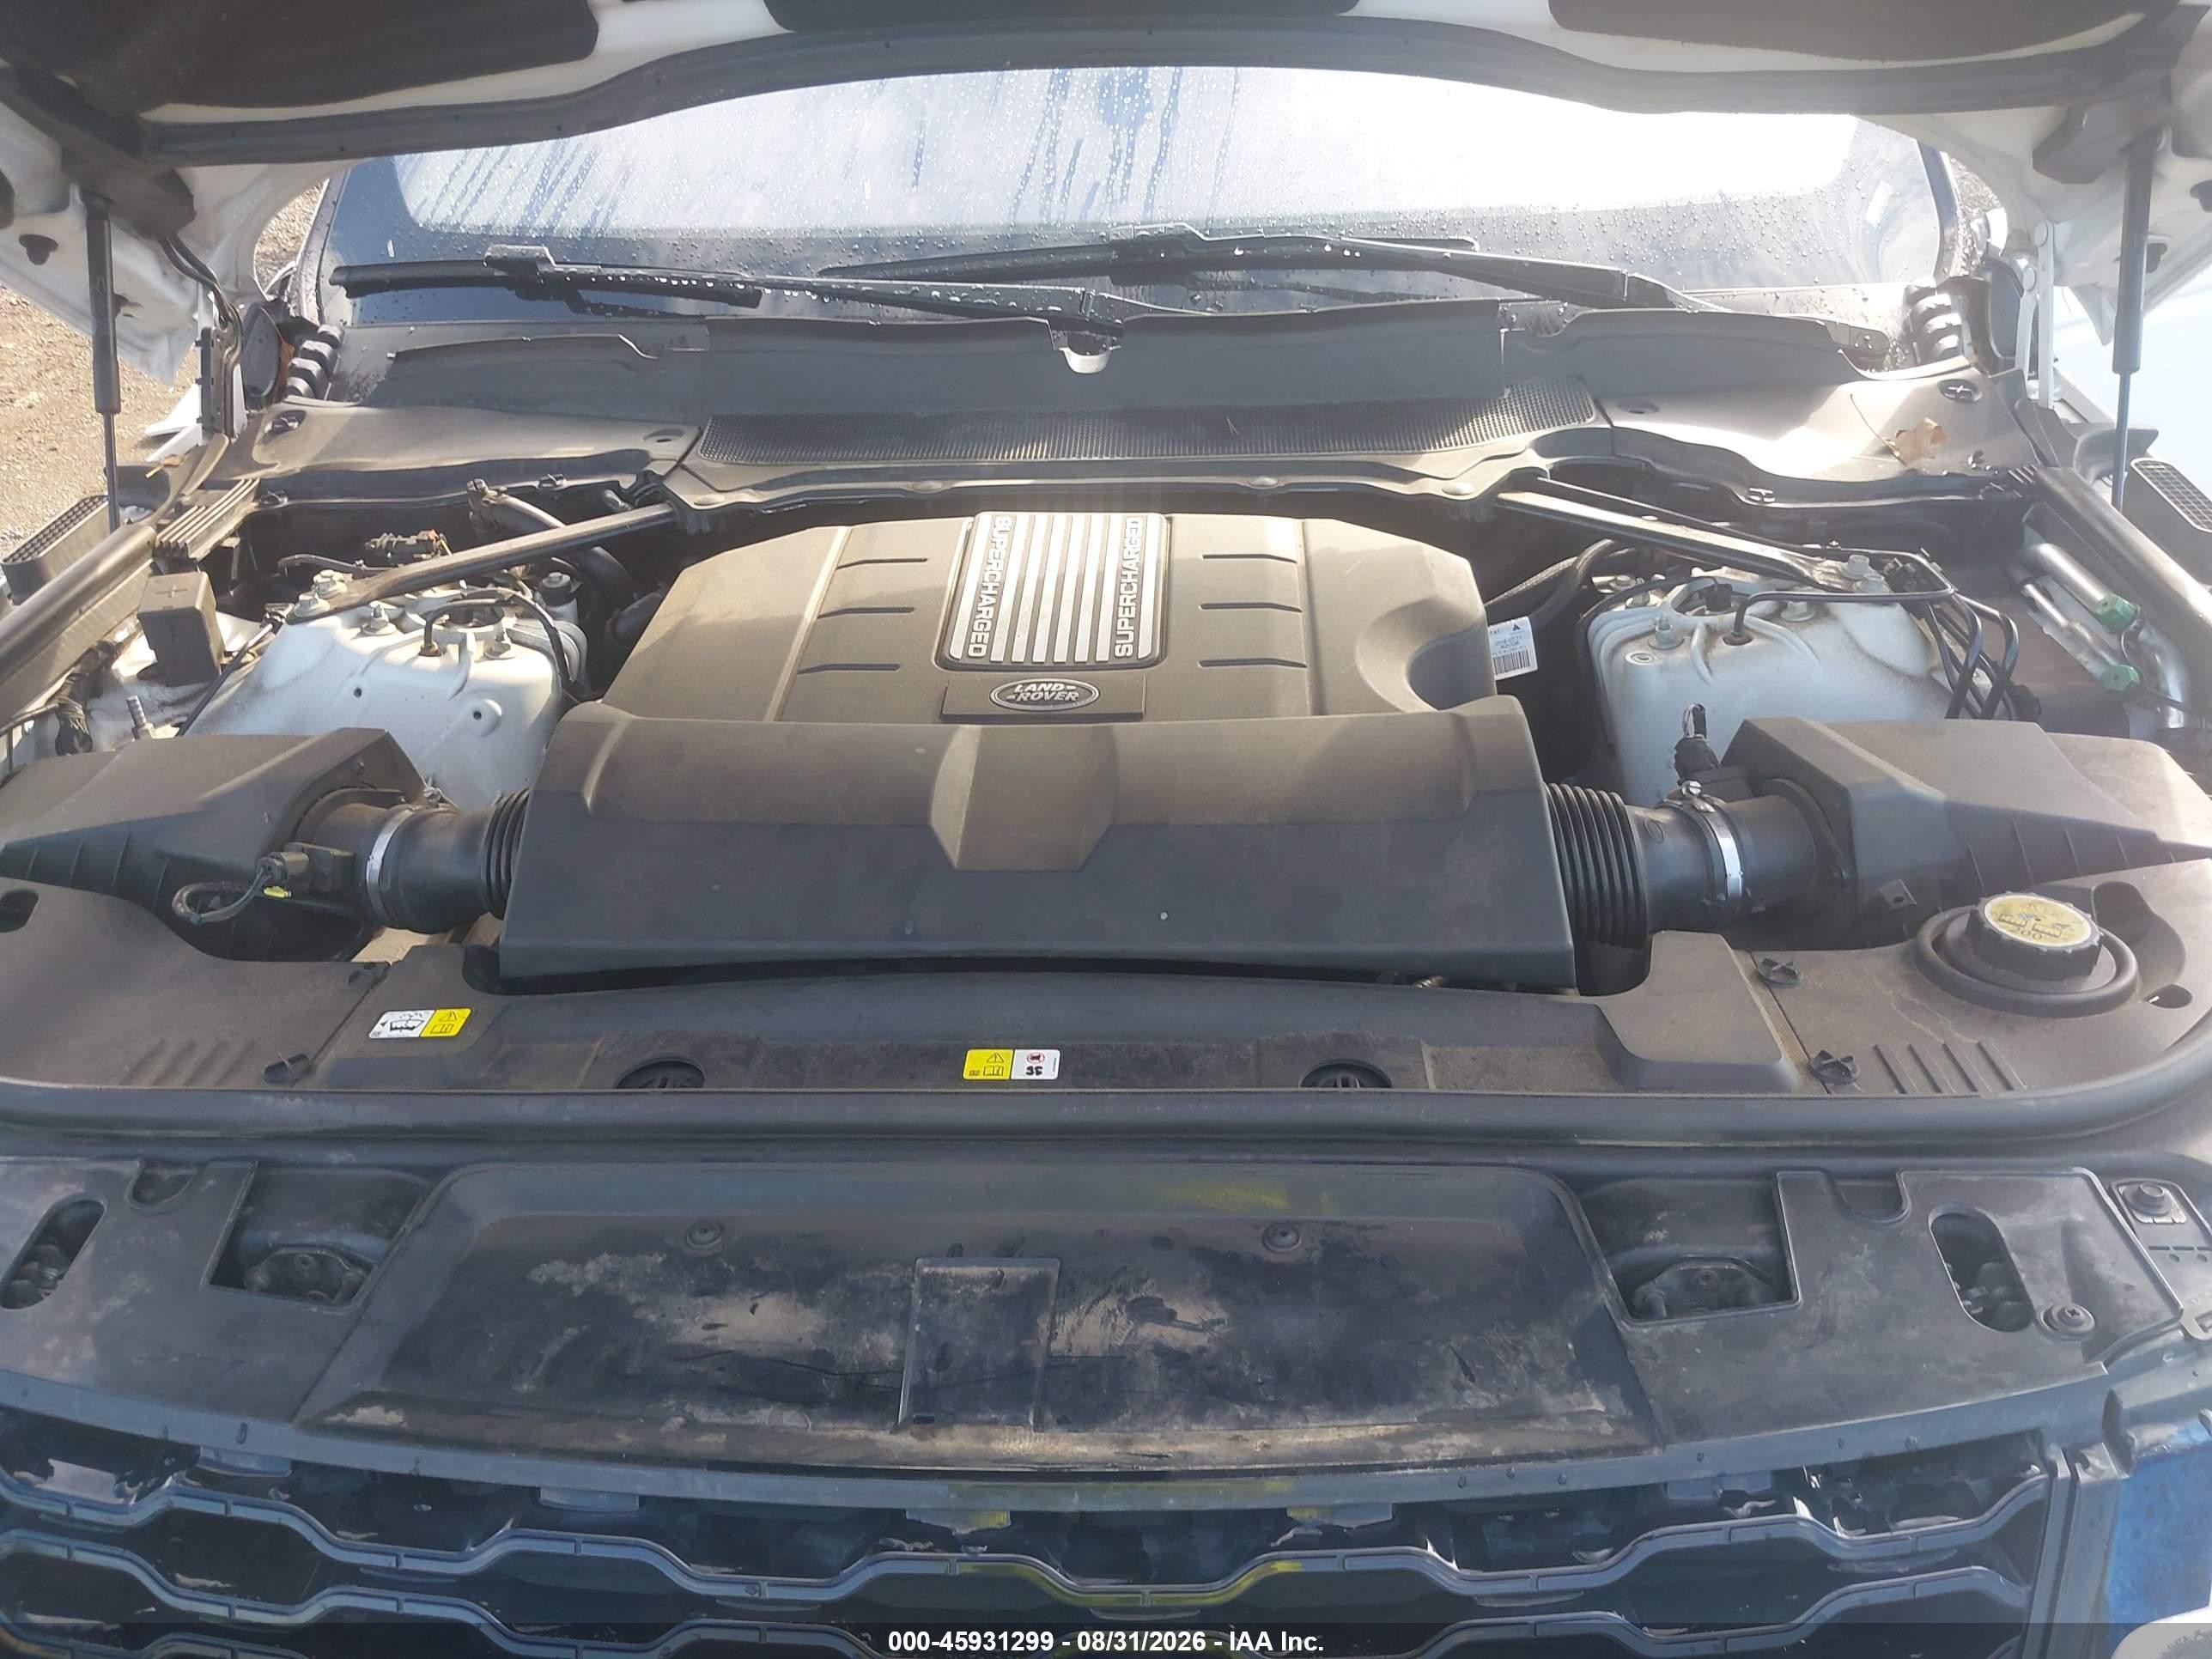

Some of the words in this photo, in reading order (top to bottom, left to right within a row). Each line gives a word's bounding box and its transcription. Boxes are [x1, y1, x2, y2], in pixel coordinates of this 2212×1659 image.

[968, 515, 1012, 658] SUPERCHARGED
[1115, 517, 1143, 659] SUPERCHARGED
[1017, 691, 1079, 702] ROVER
